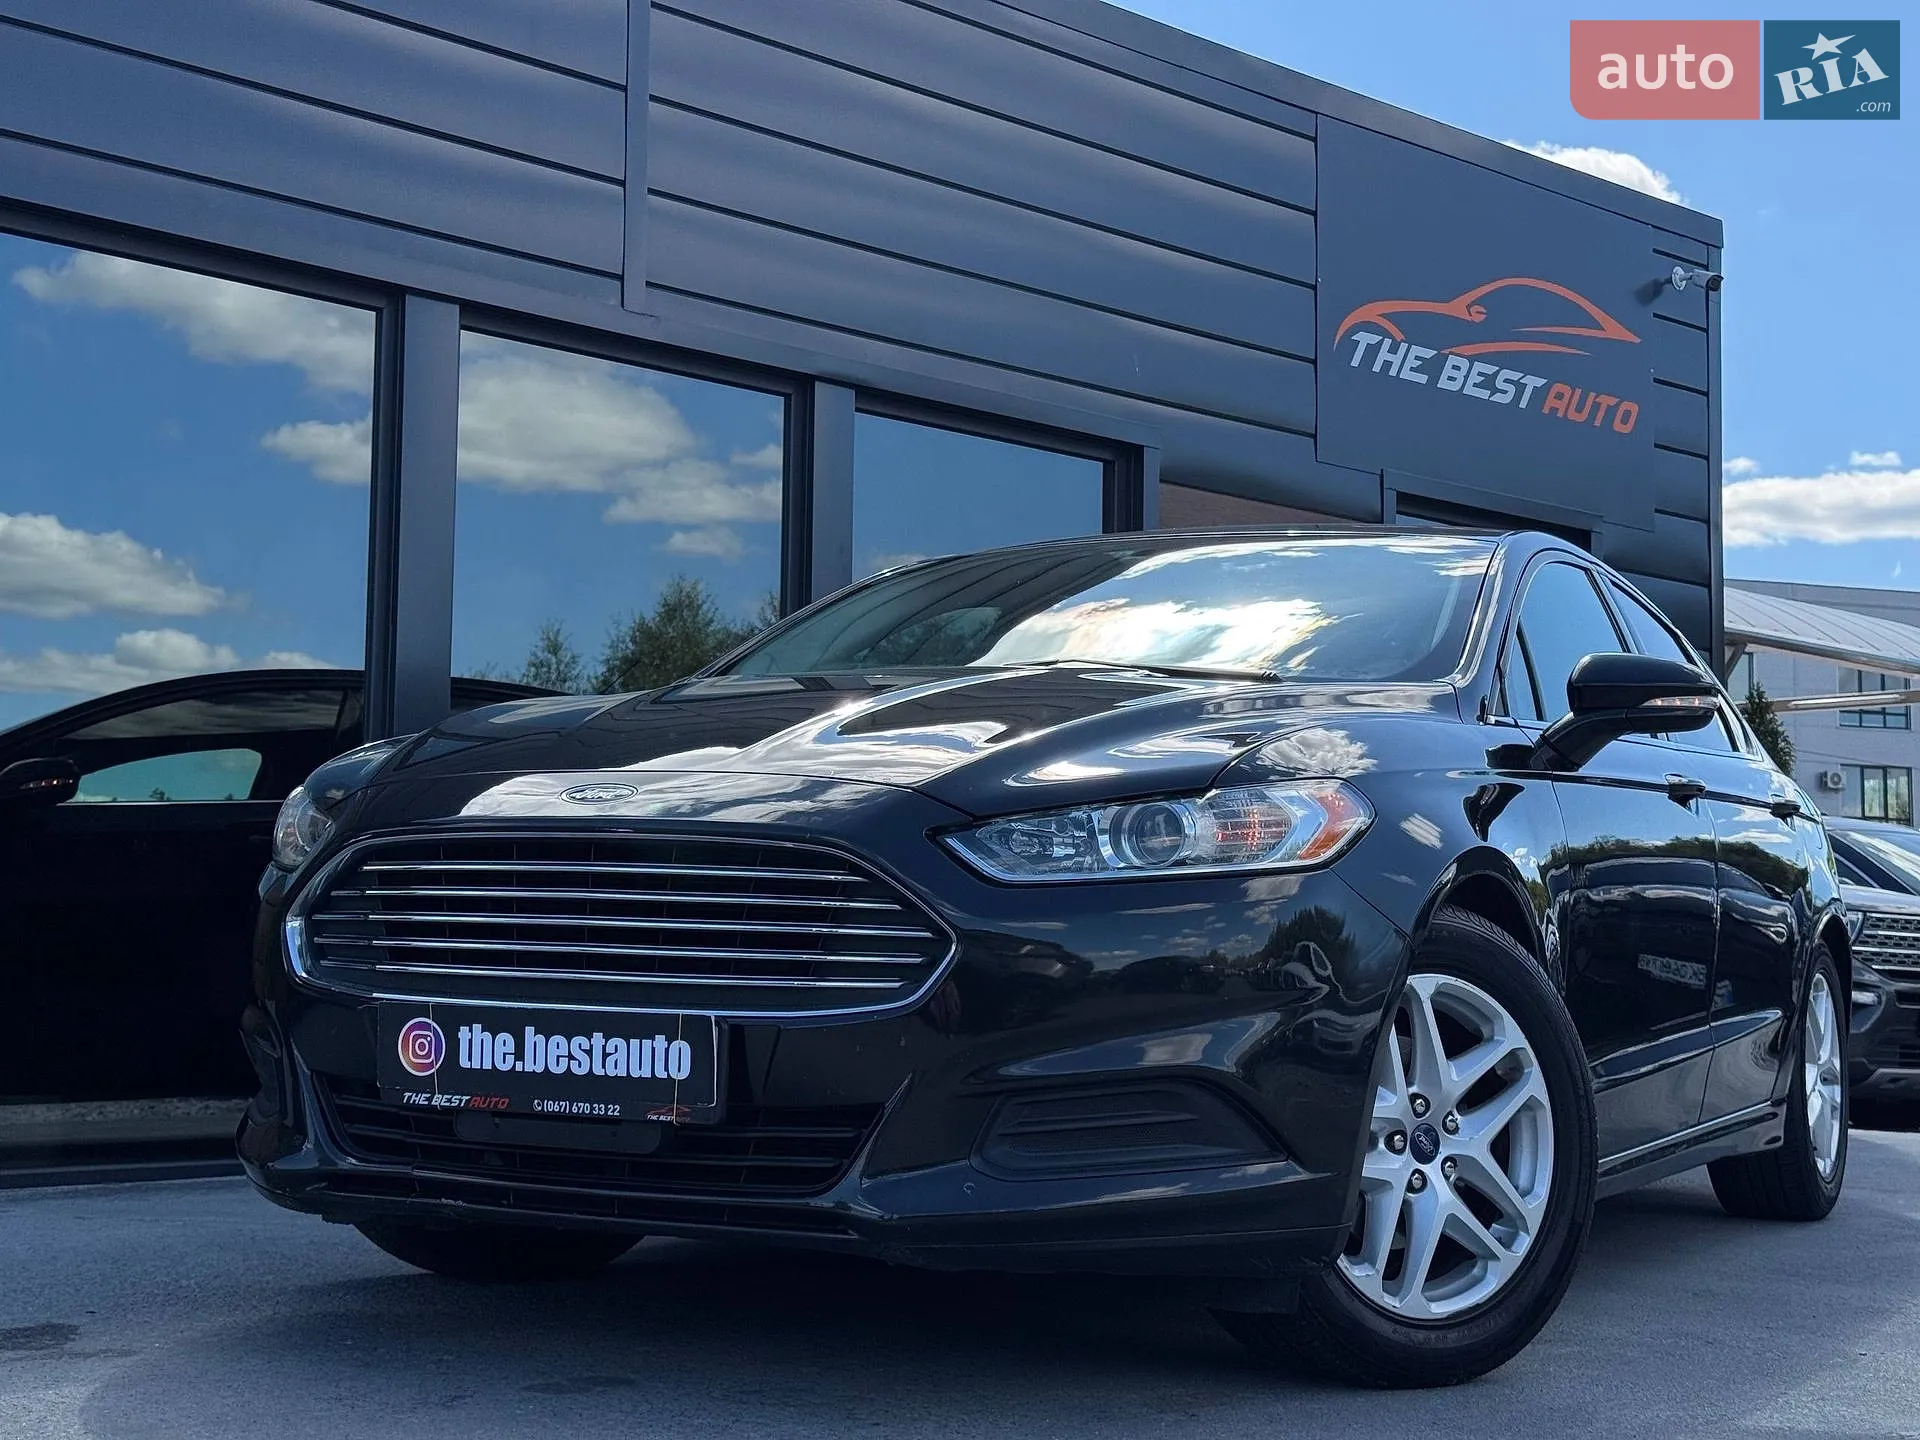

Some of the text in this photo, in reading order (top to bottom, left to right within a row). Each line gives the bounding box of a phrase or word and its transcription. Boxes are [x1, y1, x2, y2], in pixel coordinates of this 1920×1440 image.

[1350, 331, 1640, 434] THE BEST AUTO
[458, 1023, 692, 1080] the.bestauto
[403, 1092, 509, 1109] THE BEST AUTO
[543, 1099, 620, 1116] (067) 670 33 22
